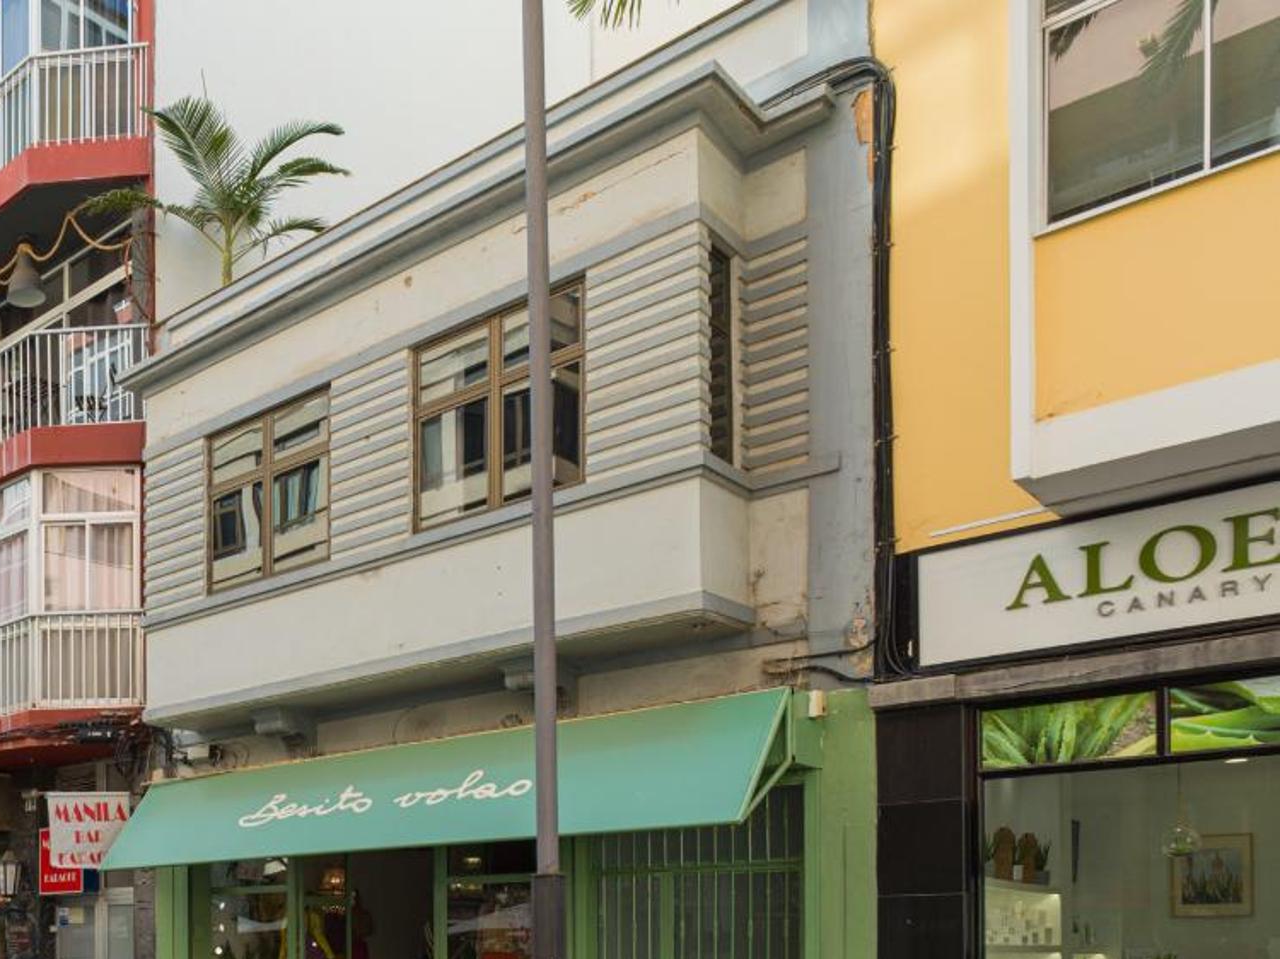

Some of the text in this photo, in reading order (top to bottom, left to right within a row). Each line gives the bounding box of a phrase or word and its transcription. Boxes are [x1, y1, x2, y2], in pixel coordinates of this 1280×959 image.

[1004, 507, 1280, 611] ALOE
[1096, 573, 1272, 618] CANARY
[394, 769, 532, 808] volao
[55, 801, 128, 823] MANILA
